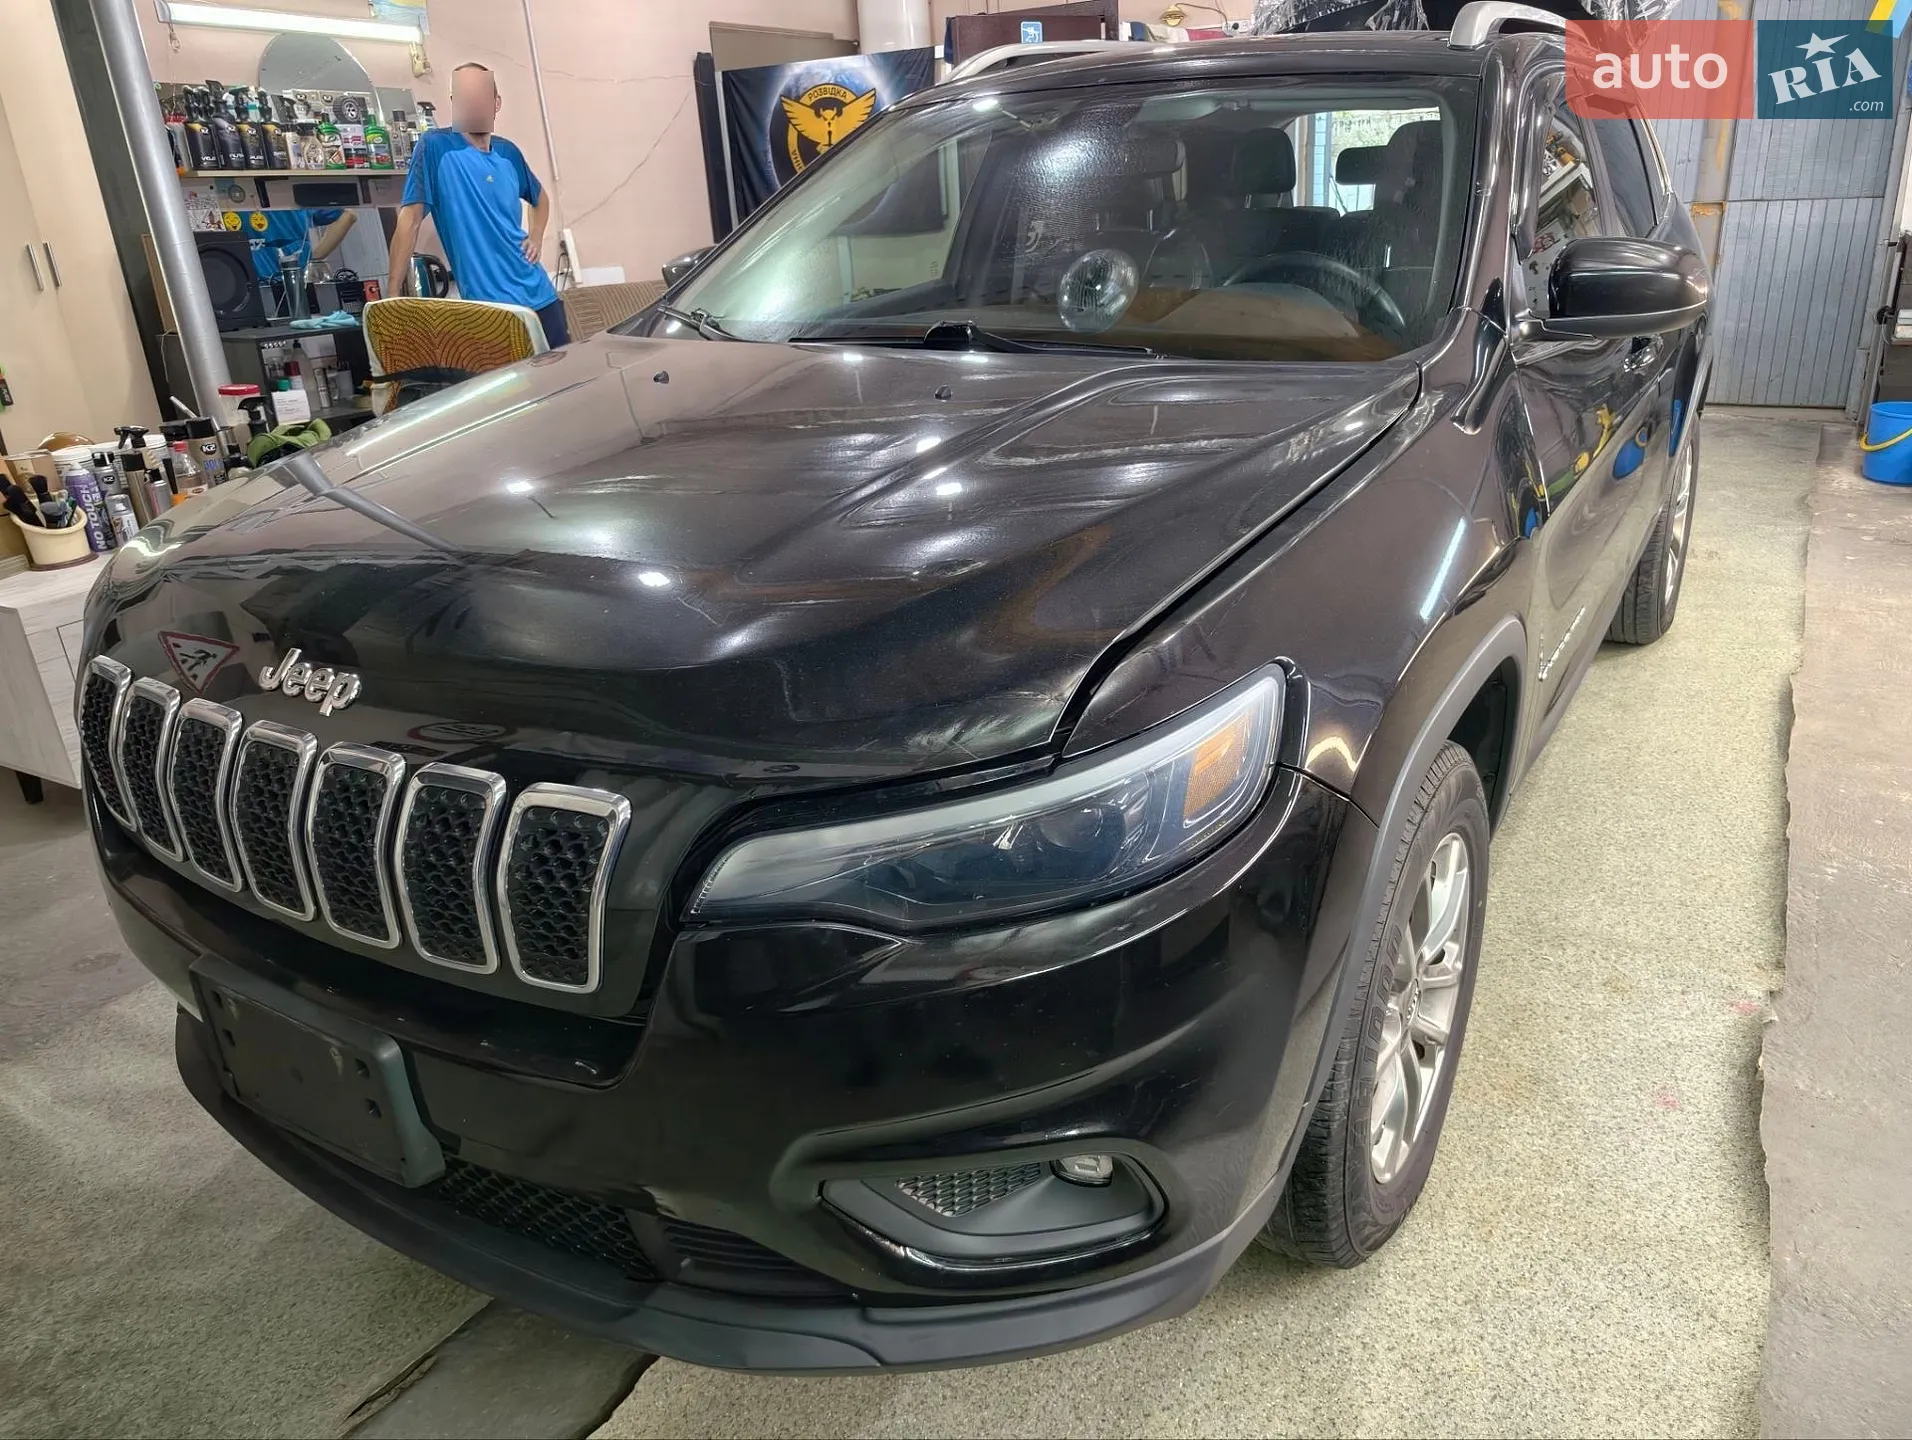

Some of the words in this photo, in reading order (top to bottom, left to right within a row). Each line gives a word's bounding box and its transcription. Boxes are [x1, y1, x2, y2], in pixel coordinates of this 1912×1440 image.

[808, 86, 847, 101] РОЗВІДКА
[202, 443, 216, 453] K2
[103, 475, 115, 483] K2
[80, 484, 100, 529] TOUCH
[93, 530, 107, 550] NO
[259, 648, 362, 716] Jeep
